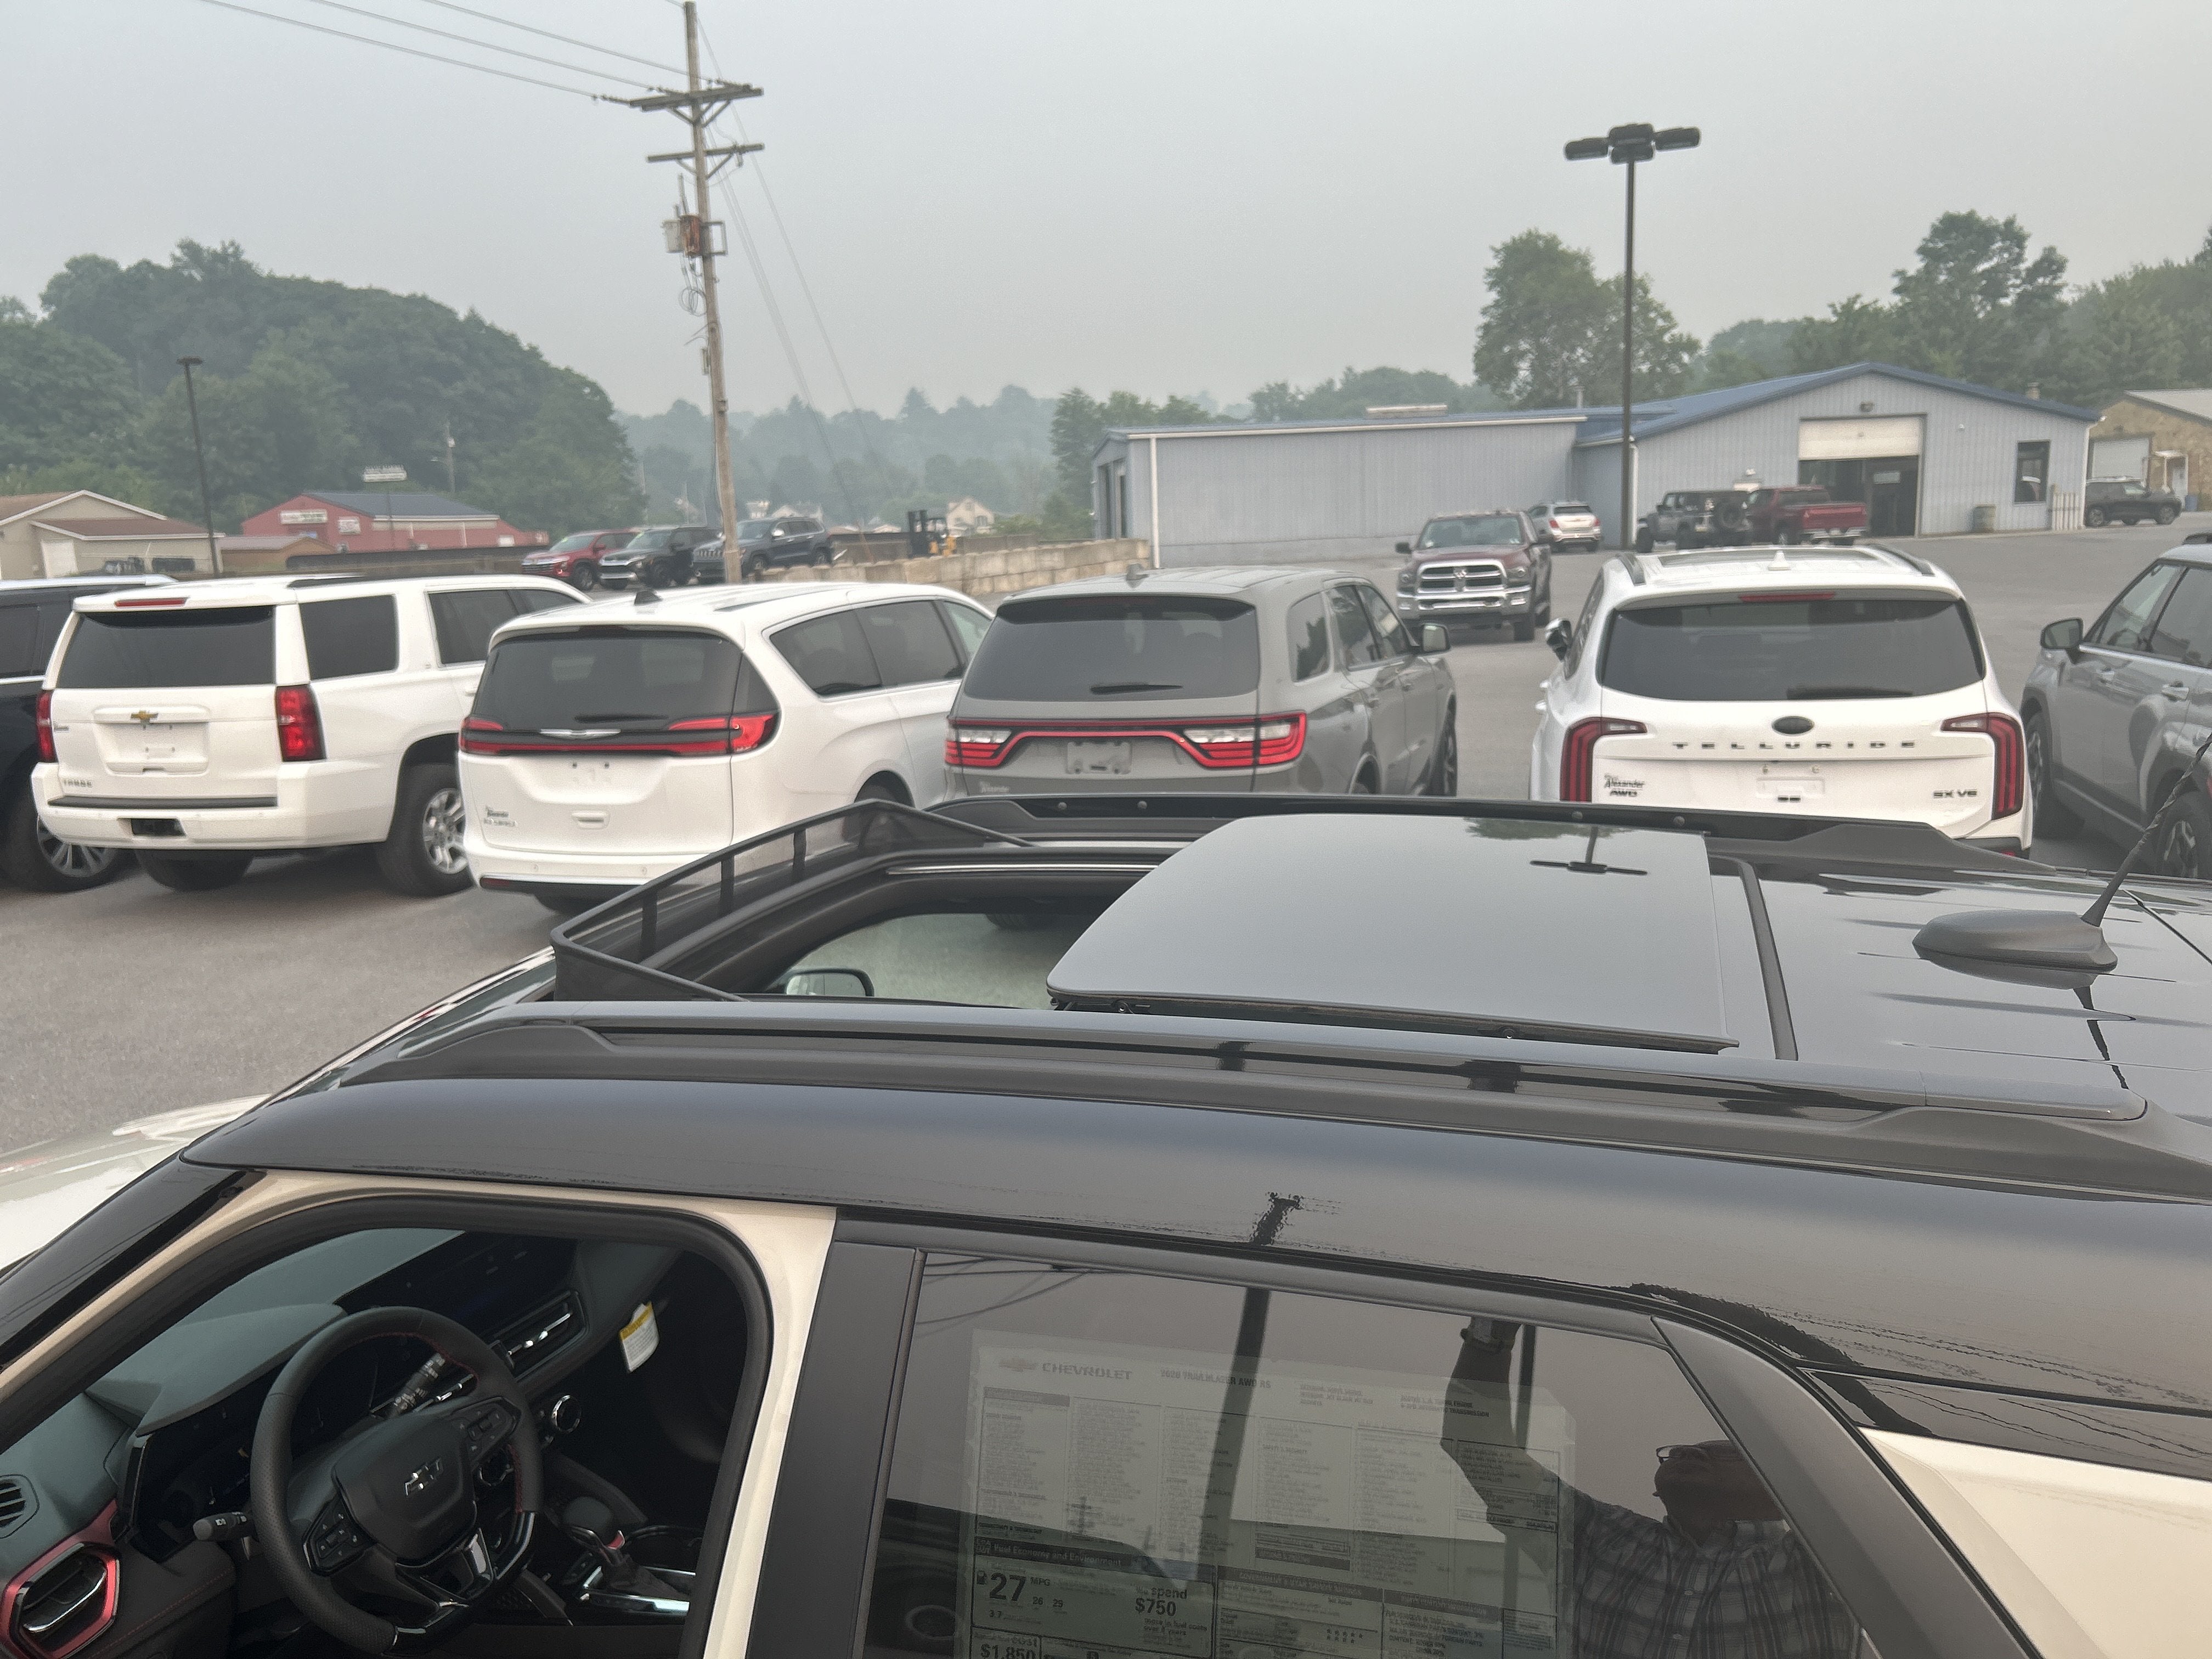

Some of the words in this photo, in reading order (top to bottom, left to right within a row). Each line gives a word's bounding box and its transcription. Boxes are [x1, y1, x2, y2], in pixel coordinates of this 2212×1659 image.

[1672, 741, 1915, 750] TELLURIDE
[1933, 789, 1955, 799] SX
[1956, 789, 1978, 798] V6
[1042, 1362, 1133, 1380] CHEVROLET
[1238, 1377, 1257, 1387] AWD
[1260, 1379, 1272, 1389] RS
[994, 1543, 1011, 1553] Fuel
[1013, 1545, 1050, 1560] Economy
[1052, 1550, 1068, 1560] and
[1069, 1551, 1122, 1567] Environment
[989, 1572, 1026, 1602] 27
[1030, 1576, 1051, 1587] MPG
[1151, 1587, 1187, 1600] spend
[1032, 1596, 1043, 1605] 26
[1052, 1598, 1064, 1609] 29
[1135, 1597, 1177, 1617] $750
